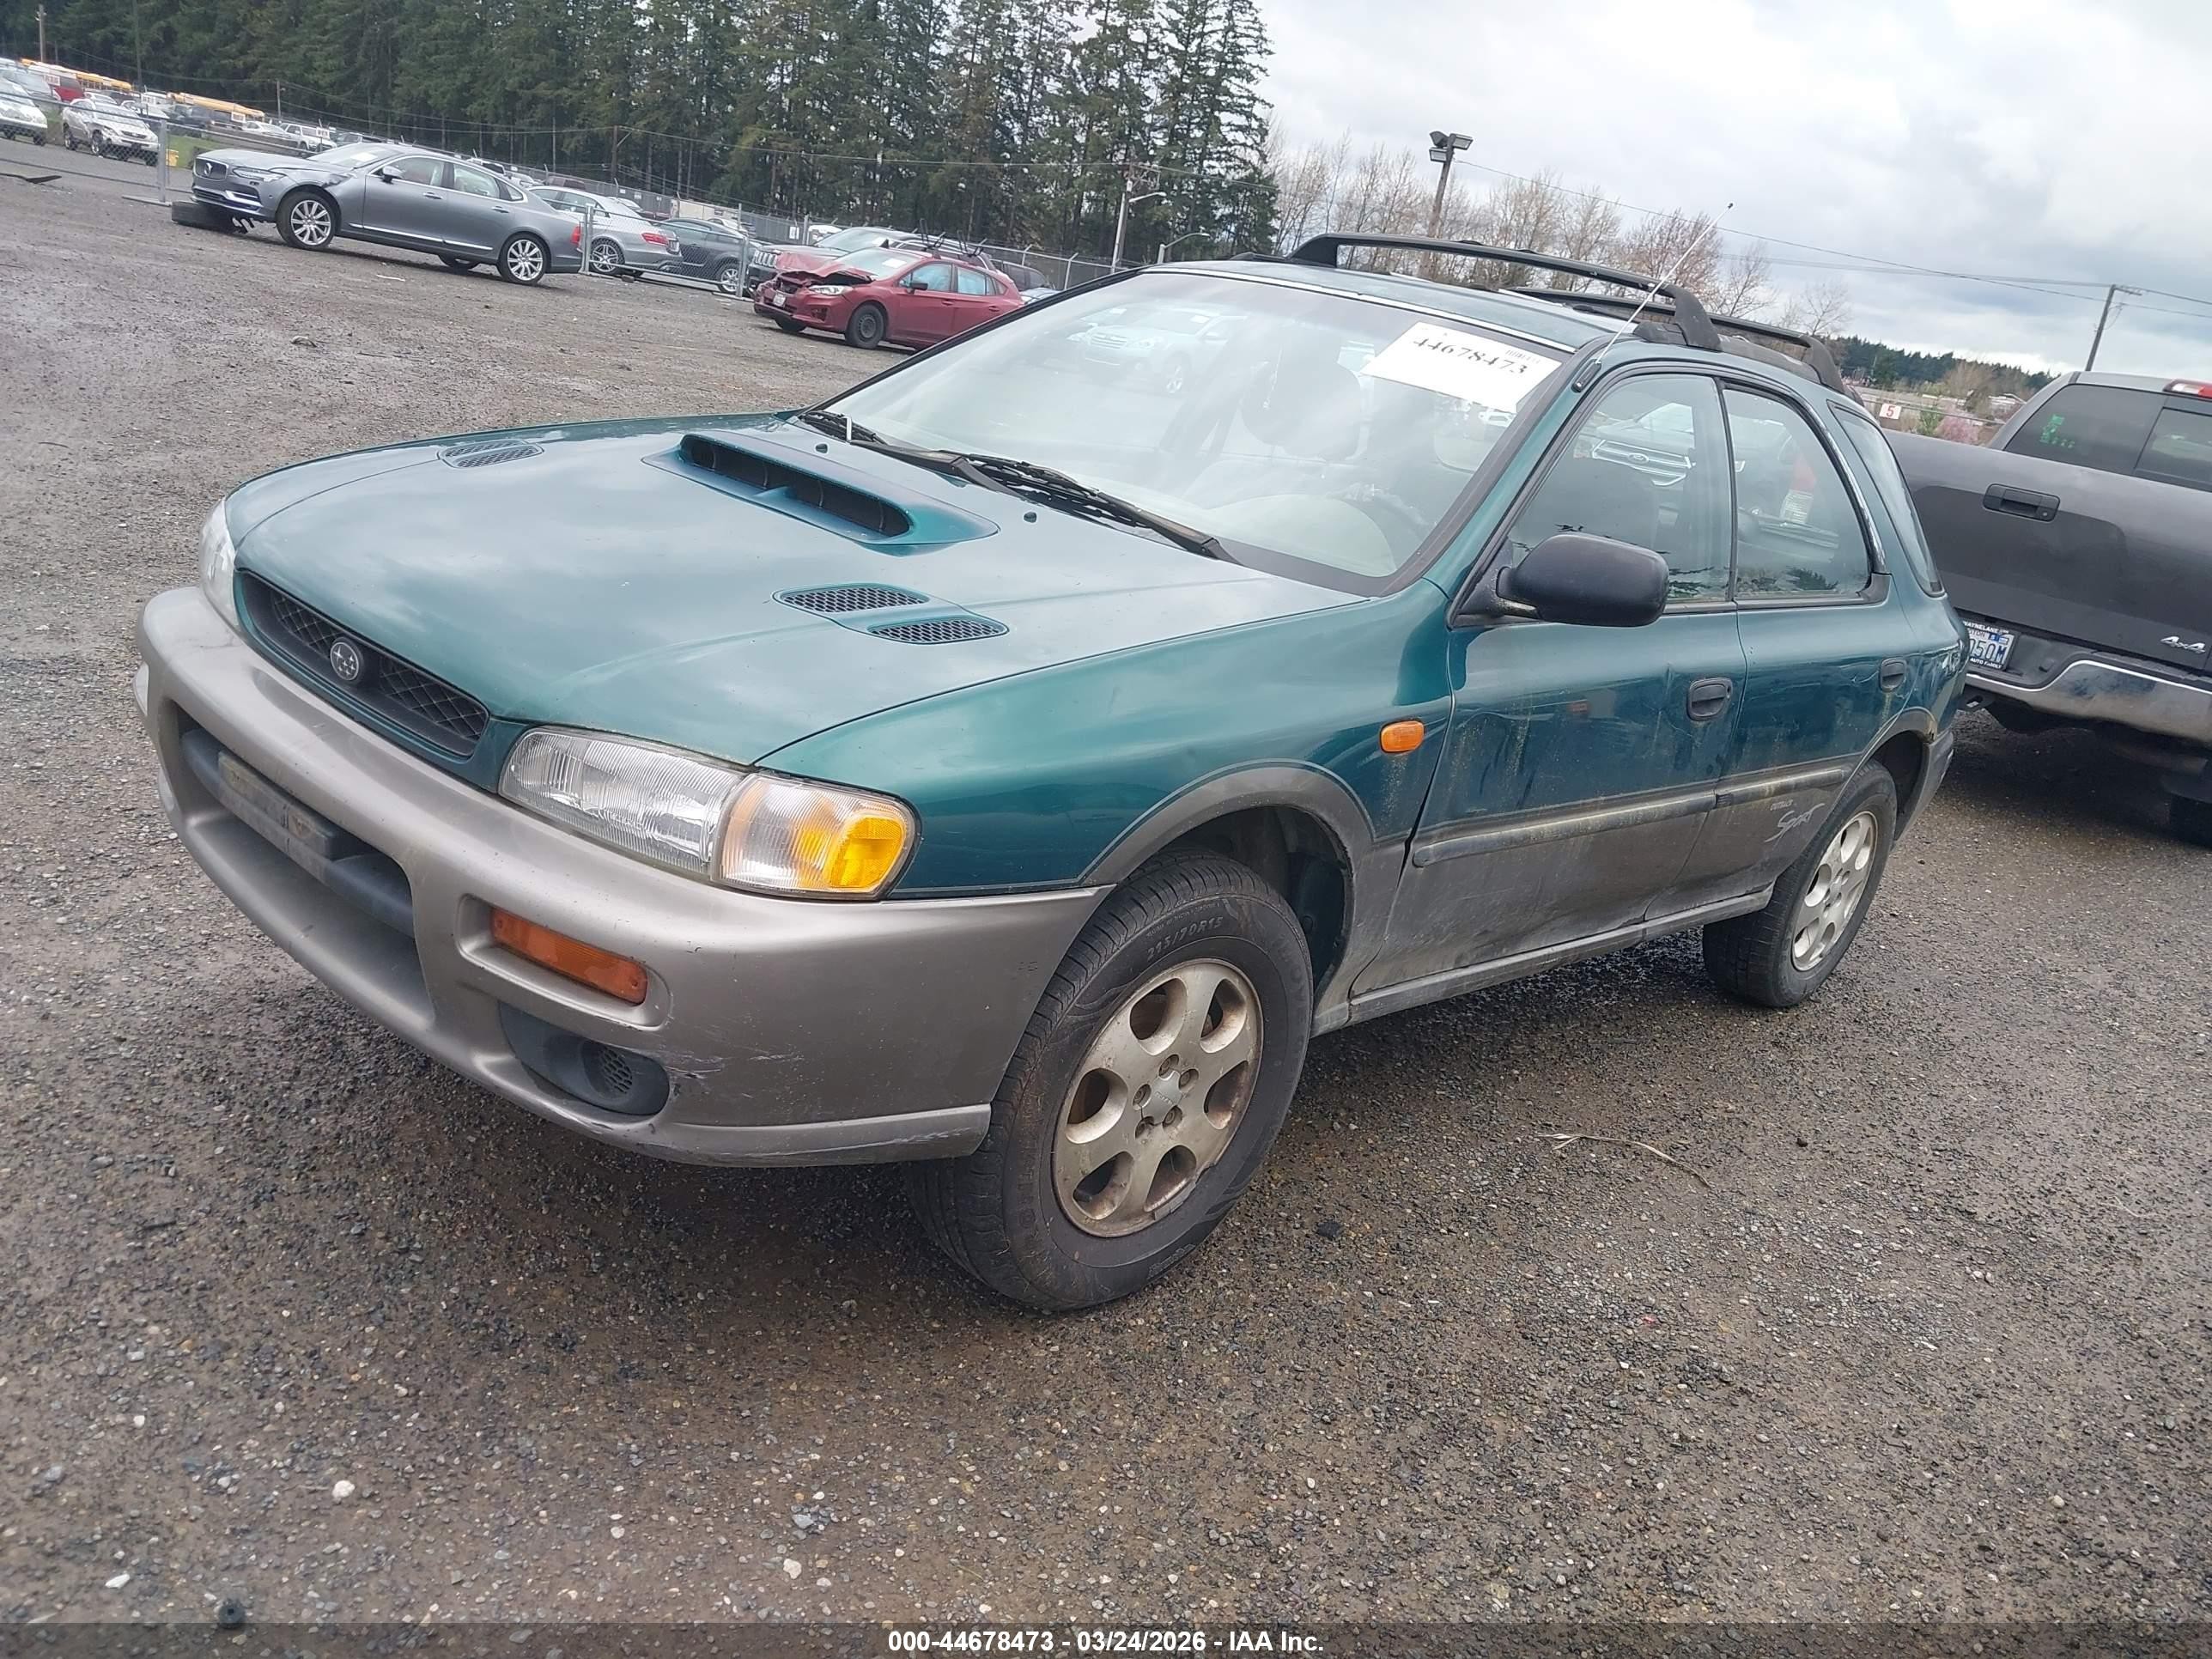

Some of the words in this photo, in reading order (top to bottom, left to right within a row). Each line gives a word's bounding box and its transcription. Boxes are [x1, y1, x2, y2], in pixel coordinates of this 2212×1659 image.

[1413, 337, 1528, 374] 44678473
[1886, 405, 1896, 417] 5
[2160, 635, 2206, 653] 4x4
